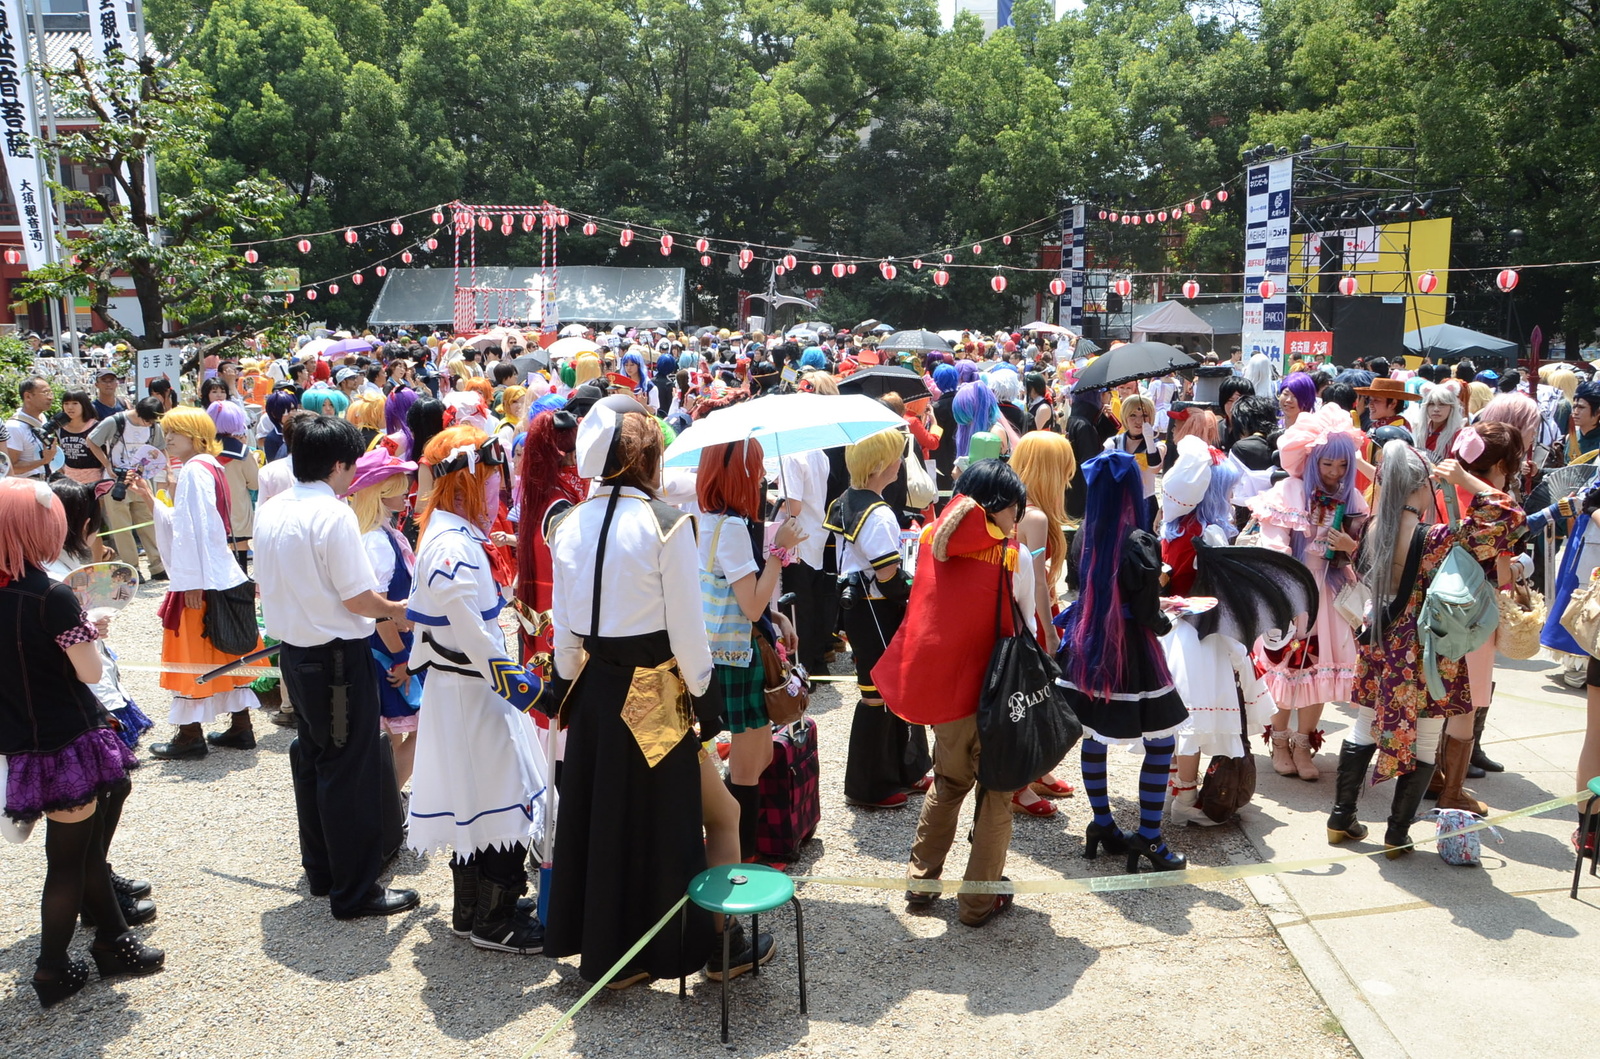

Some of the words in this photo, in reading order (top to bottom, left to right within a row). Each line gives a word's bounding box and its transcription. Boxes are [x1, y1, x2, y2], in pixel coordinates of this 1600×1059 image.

[20, 179, 44, 252] 大須観音通り
[1264, 311, 1284, 323] PARCO
[1290, 341, 1310, 353] 名古屋
[1313, 341, 1328, 354] 大須
[142, 353, 174, 369] お手洗
